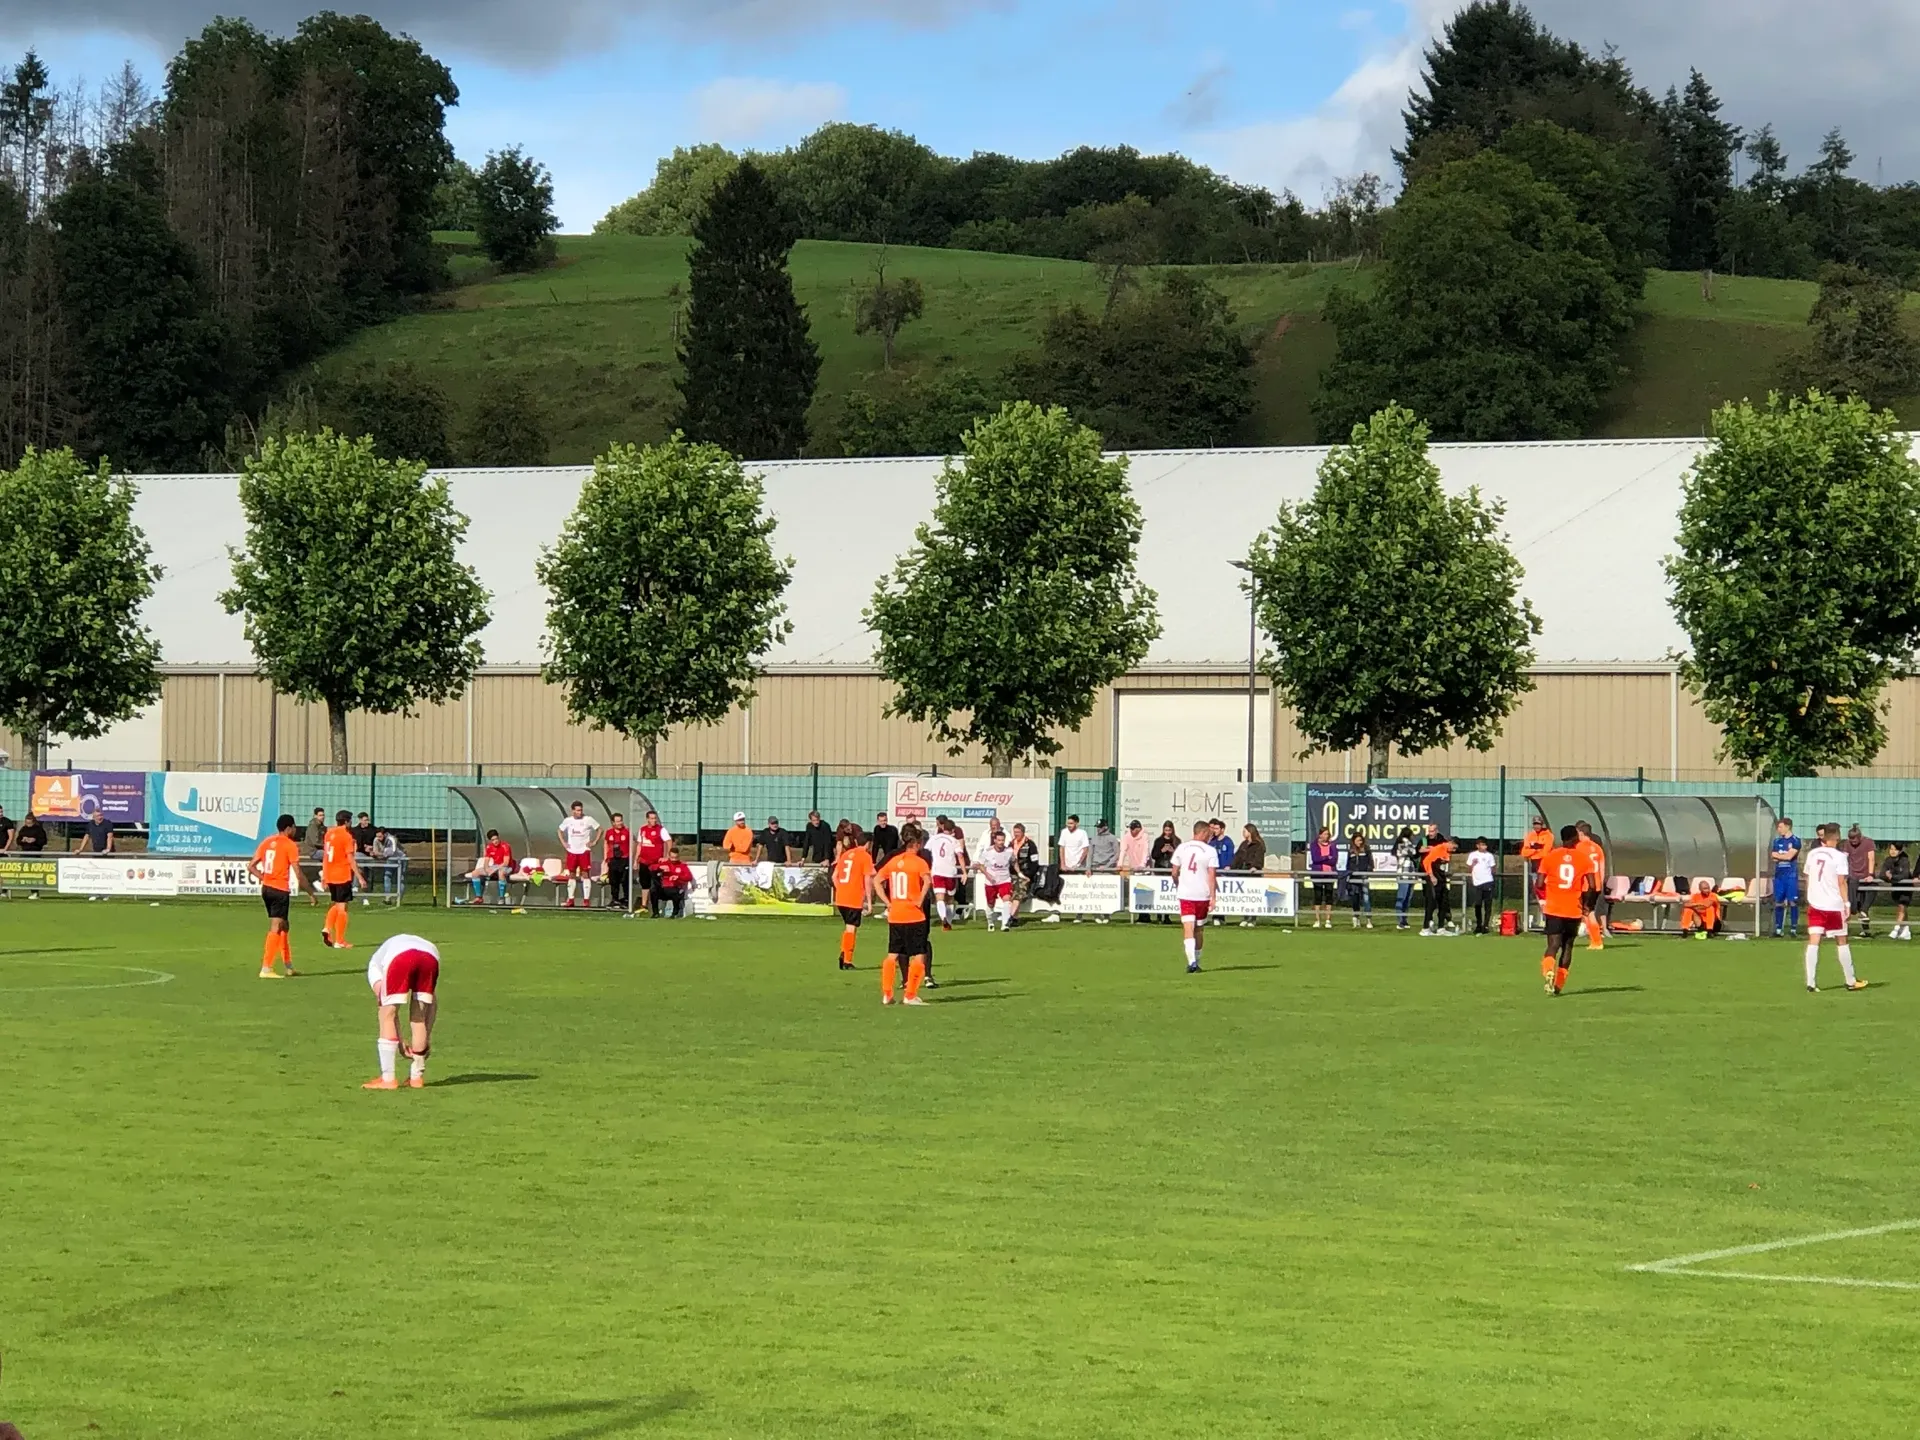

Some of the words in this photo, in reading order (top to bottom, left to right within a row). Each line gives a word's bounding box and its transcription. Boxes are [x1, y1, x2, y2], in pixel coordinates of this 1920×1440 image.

[199, 797, 259, 813] LUXGLASS
[920, 790, 972, 802] Eschbour
[974, 791, 1014, 806] Energy
[1172, 788, 1238, 818] HOME
[965, 808, 996, 818] SANITÄR
[1349, 804, 1368, 820] JP
[1374, 804, 1430, 820] HOME
[938, 843, 948, 858] 6
[23, 862, 30, 872] &
[31, 862, 57, 872] KRAUS
[840, 860, 853, 883] 3
[1188, 853, 1198, 874] 4
[1816, 859, 1826, 882] 7
[157, 870, 173, 878] Jeep
[205, 869, 261, 885] LEWEC
[1558, 863, 1575, 889] 9
[891, 871, 908, 899] 10
